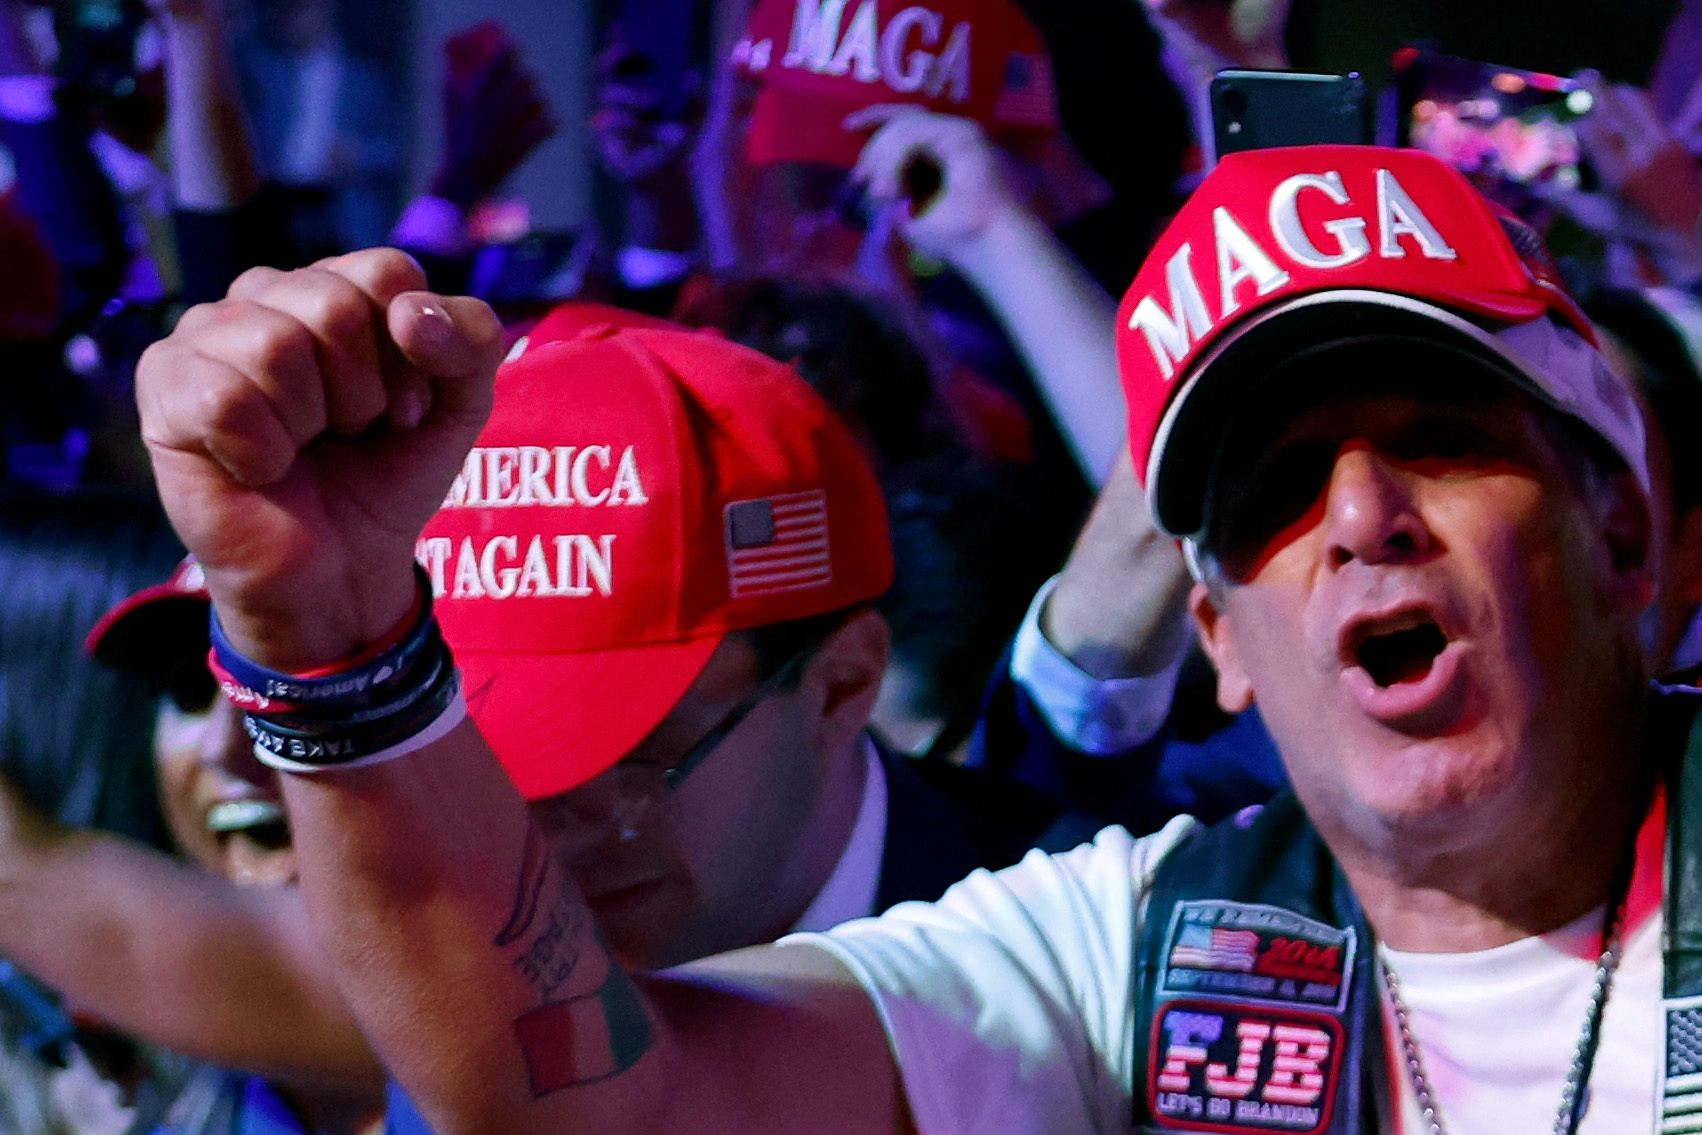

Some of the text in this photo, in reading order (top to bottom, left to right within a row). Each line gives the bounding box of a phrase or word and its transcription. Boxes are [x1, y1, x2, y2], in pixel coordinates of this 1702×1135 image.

[781, 0, 972, 104] MAGA
[1129, 168, 1458, 380] MAGA
[438, 445, 650, 508] MERICA
[452, 533, 618, 599] AGAIN
[1157, 1010, 1332, 1105] FJB
